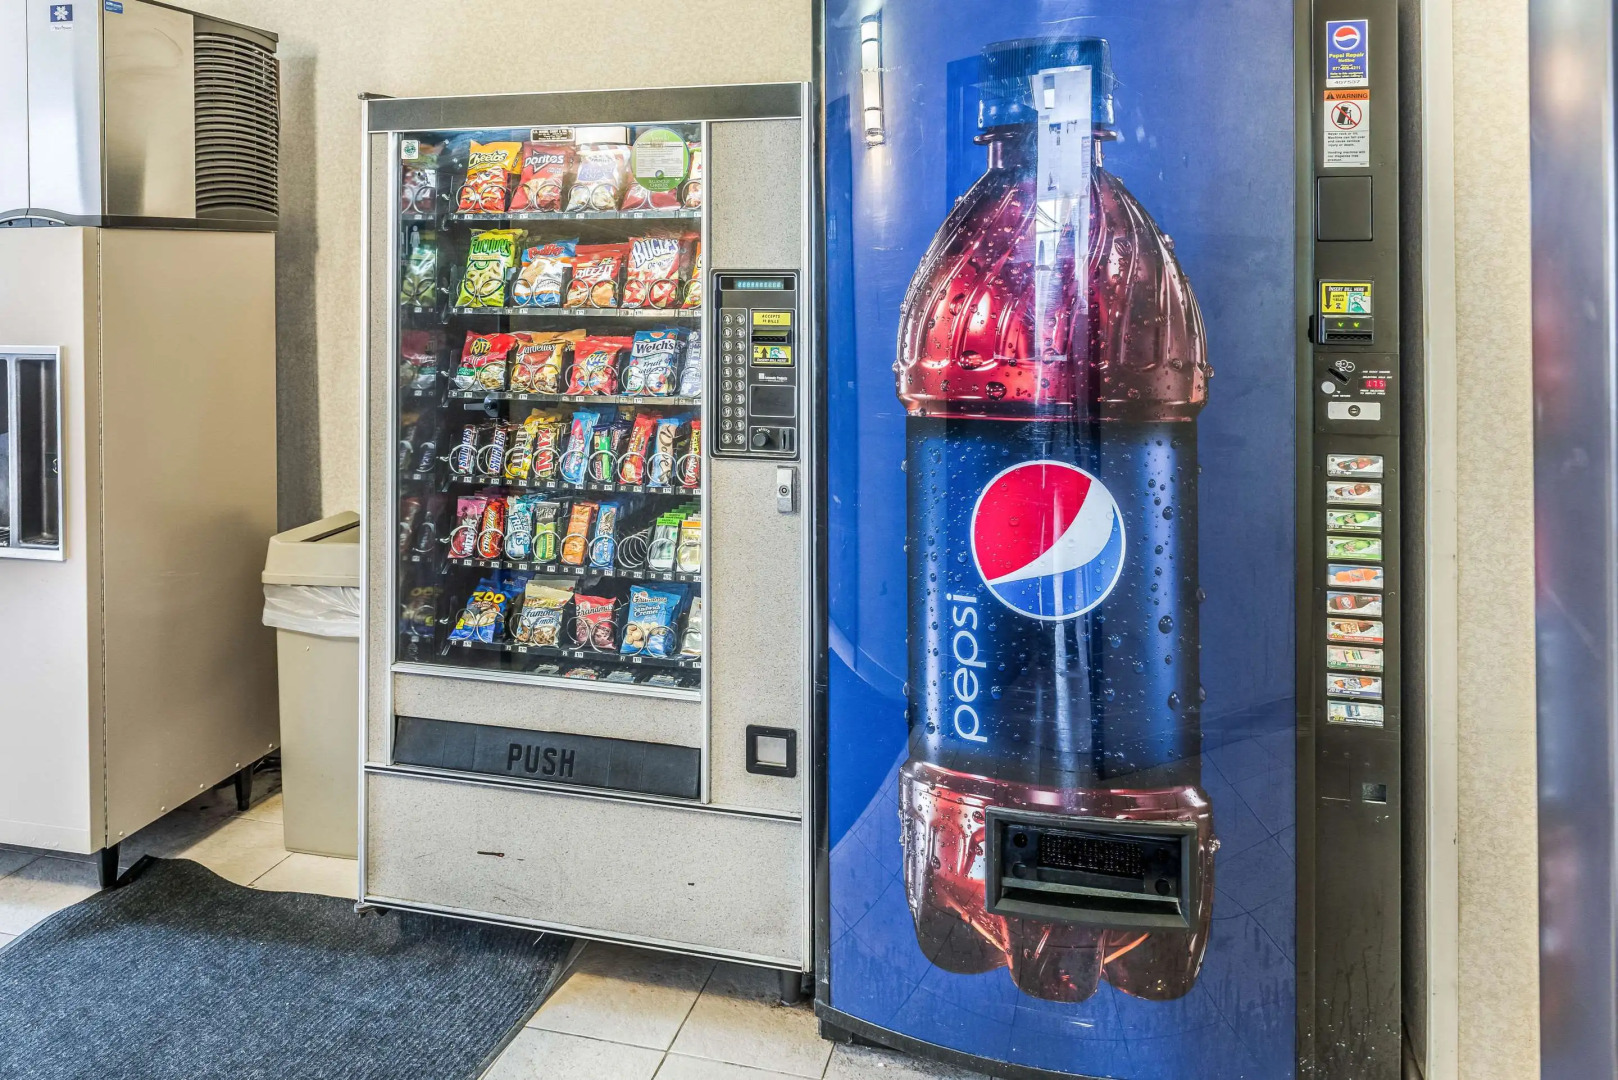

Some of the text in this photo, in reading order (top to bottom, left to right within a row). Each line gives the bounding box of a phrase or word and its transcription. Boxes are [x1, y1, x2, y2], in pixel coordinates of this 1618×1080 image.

[468, 150, 508, 169] Cheetos
[524, 154, 565, 167] Doritos
[469, 237, 512, 257] Funyuns
[632, 239, 679, 269] BUGLES
[472, 340, 492, 355] RITZ
[636, 340, 675, 354] Welch's
[458, 428, 472, 467] SNICERS
[536, 429, 553, 472] TWIX
[472, 592, 506, 604] ZOO
[946, 592, 988, 743] pepsi
[507, 743, 575, 778] PUSH
